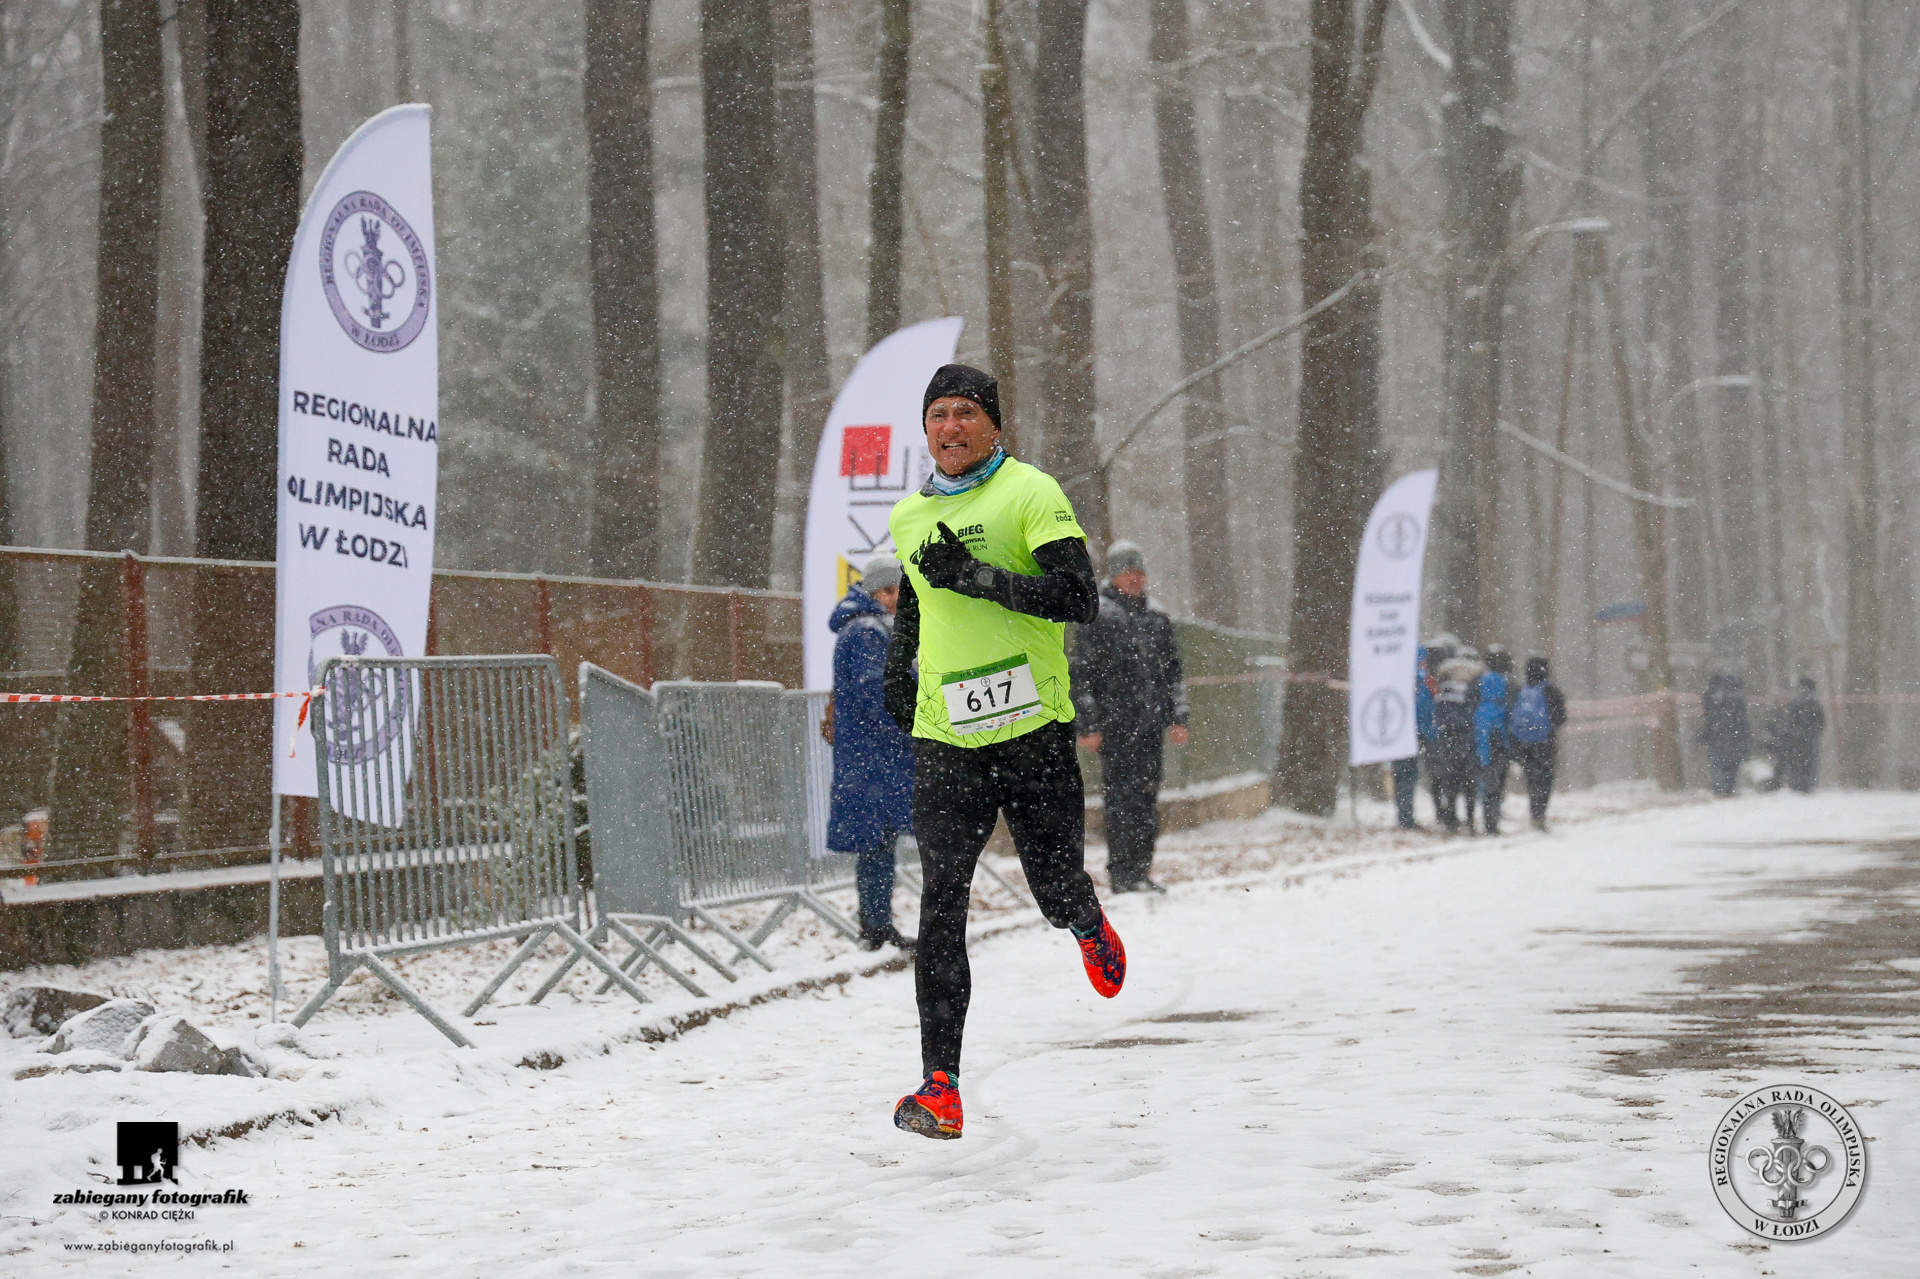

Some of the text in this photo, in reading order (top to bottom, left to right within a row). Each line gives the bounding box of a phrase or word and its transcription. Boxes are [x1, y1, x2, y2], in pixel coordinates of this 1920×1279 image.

[293, 390, 438, 443] REGIONALNA
[327, 438, 391, 478] RADA
[287, 475, 428, 530] OLIMPIJSKA
[298, 523, 409, 568] W ŁODZI
[957, 523, 984, 538] BIEG
[966, 680, 1012, 712] 617
